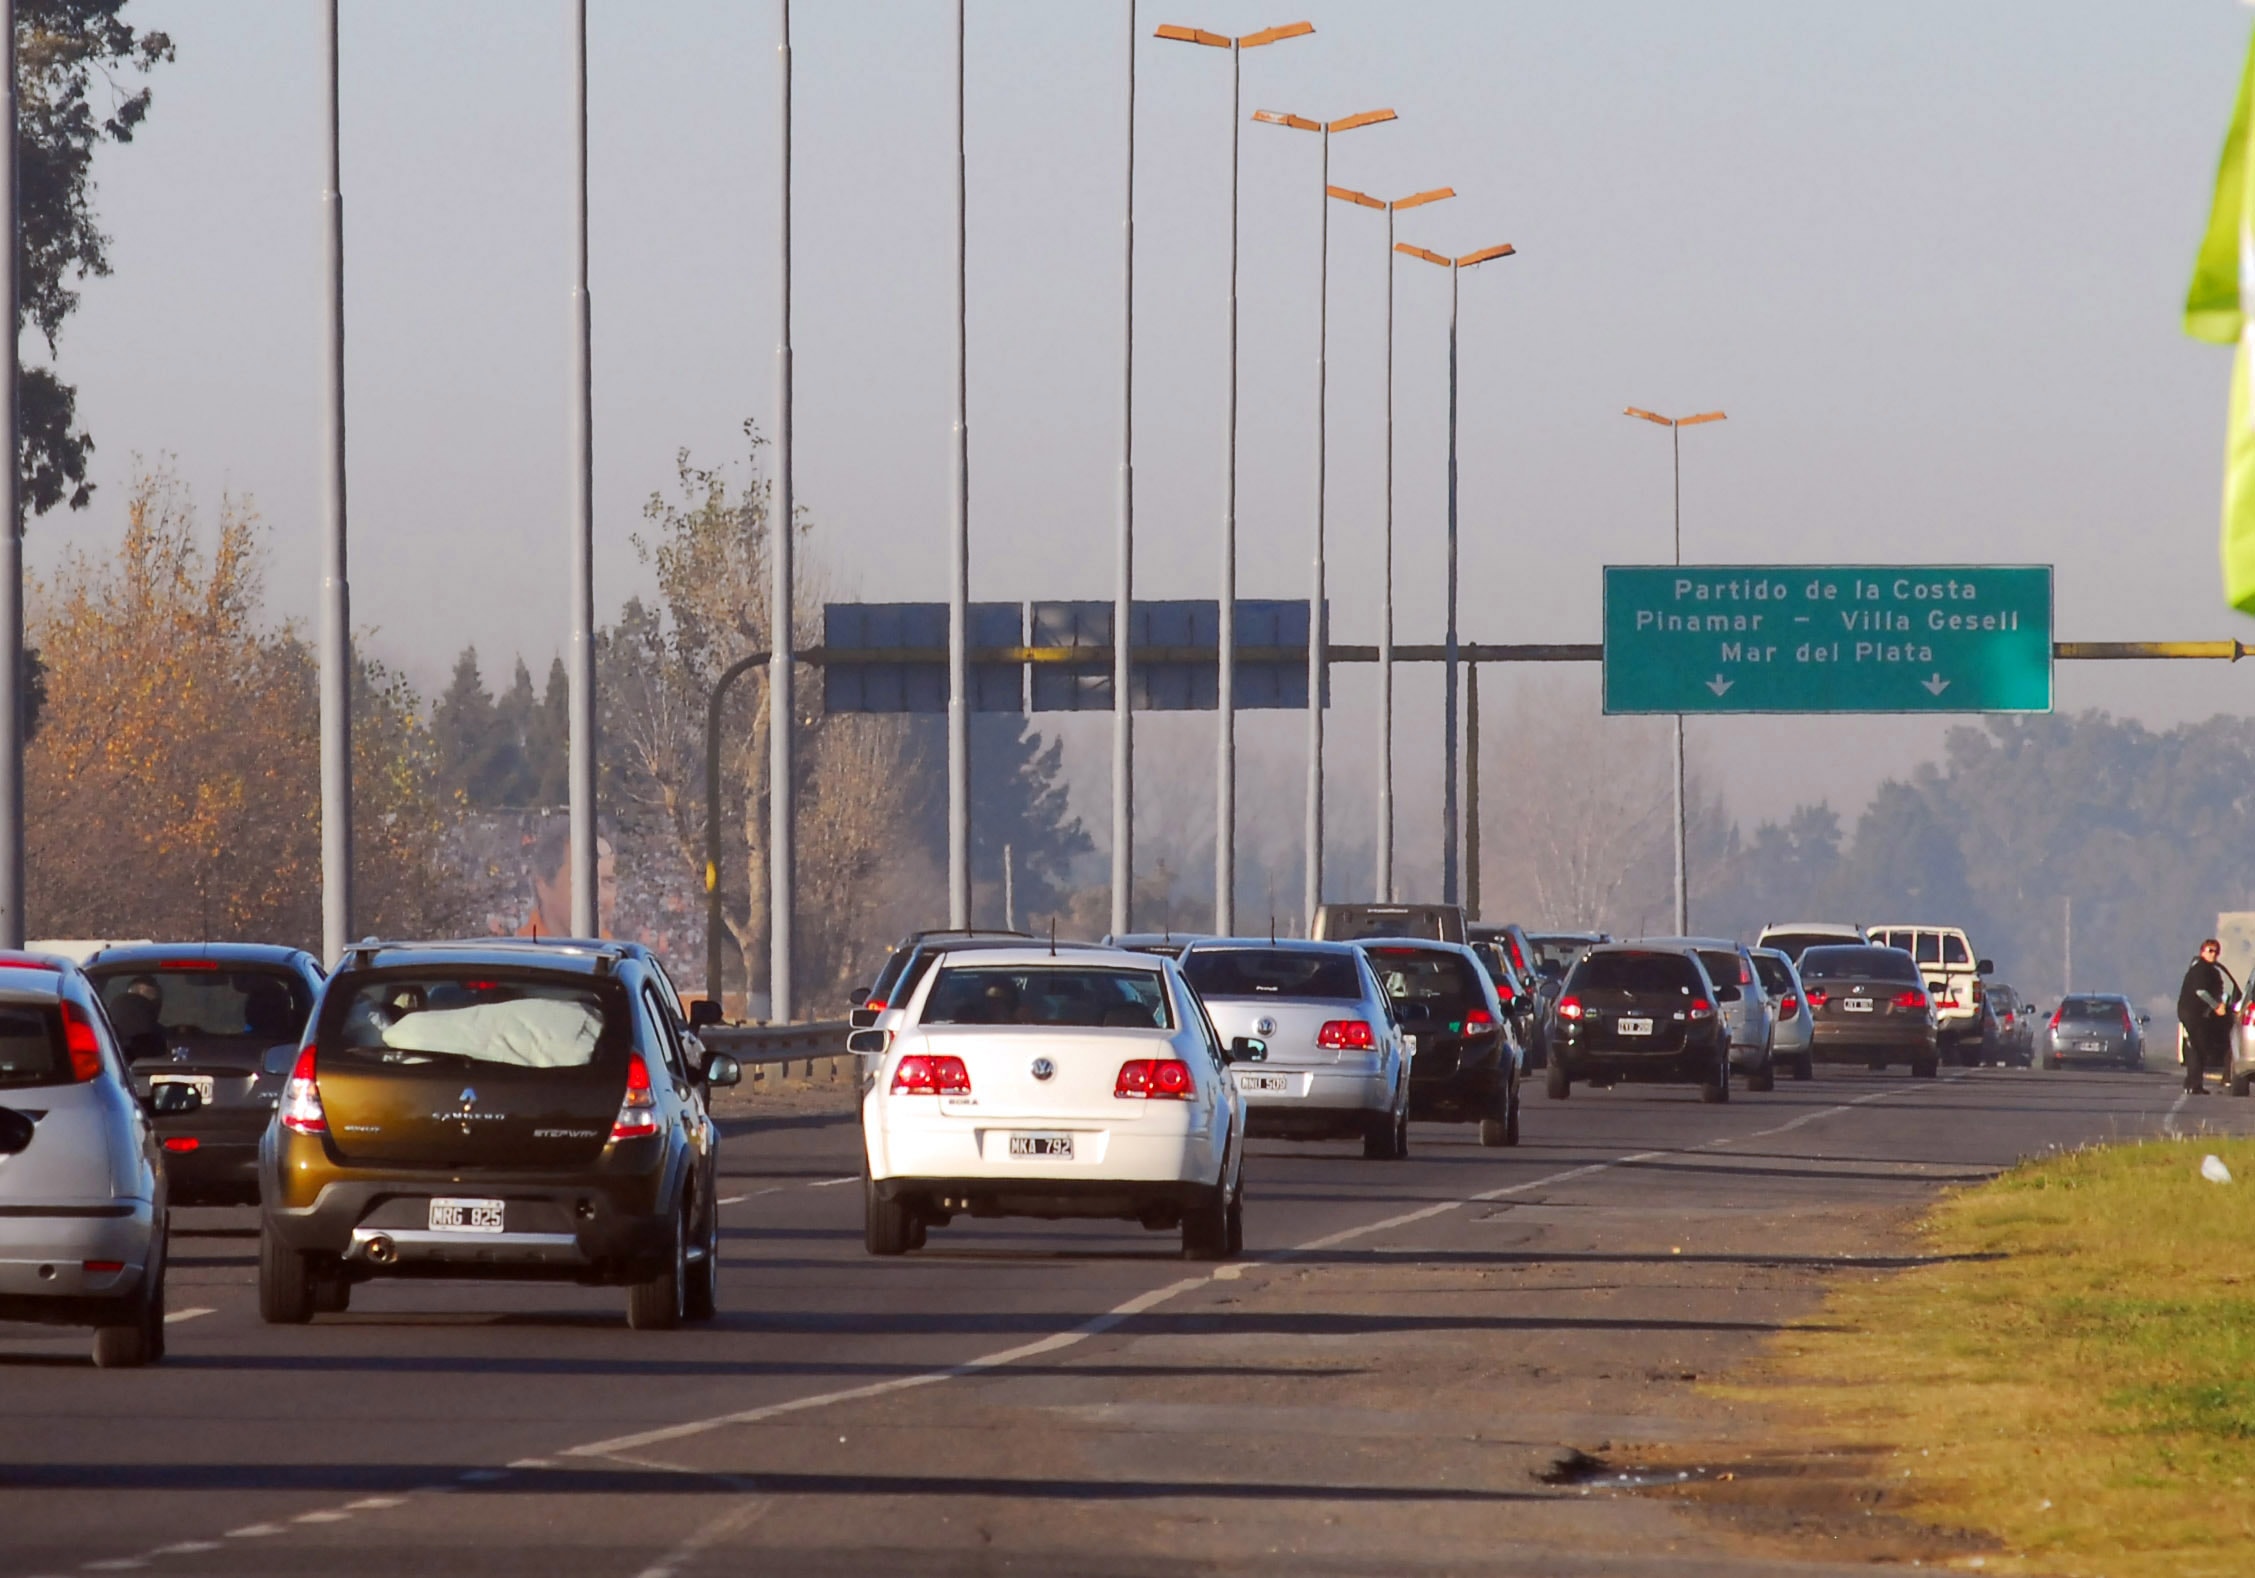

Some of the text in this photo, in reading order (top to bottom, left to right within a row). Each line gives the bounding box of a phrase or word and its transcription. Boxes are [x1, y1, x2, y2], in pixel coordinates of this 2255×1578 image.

[1675, 579, 1977, 600] Partido de la Costa
[1636, 611, 1763, 631] Pinamar
[1841, 610, 1910, 631] Villa
[1927, 610, 2019, 631] Gesell
[1721, 642, 1933, 662] Mar del Plata
[1011, 1138, 1071, 1155] MKA 792
[433, 1207, 501, 1227] MRG 825
